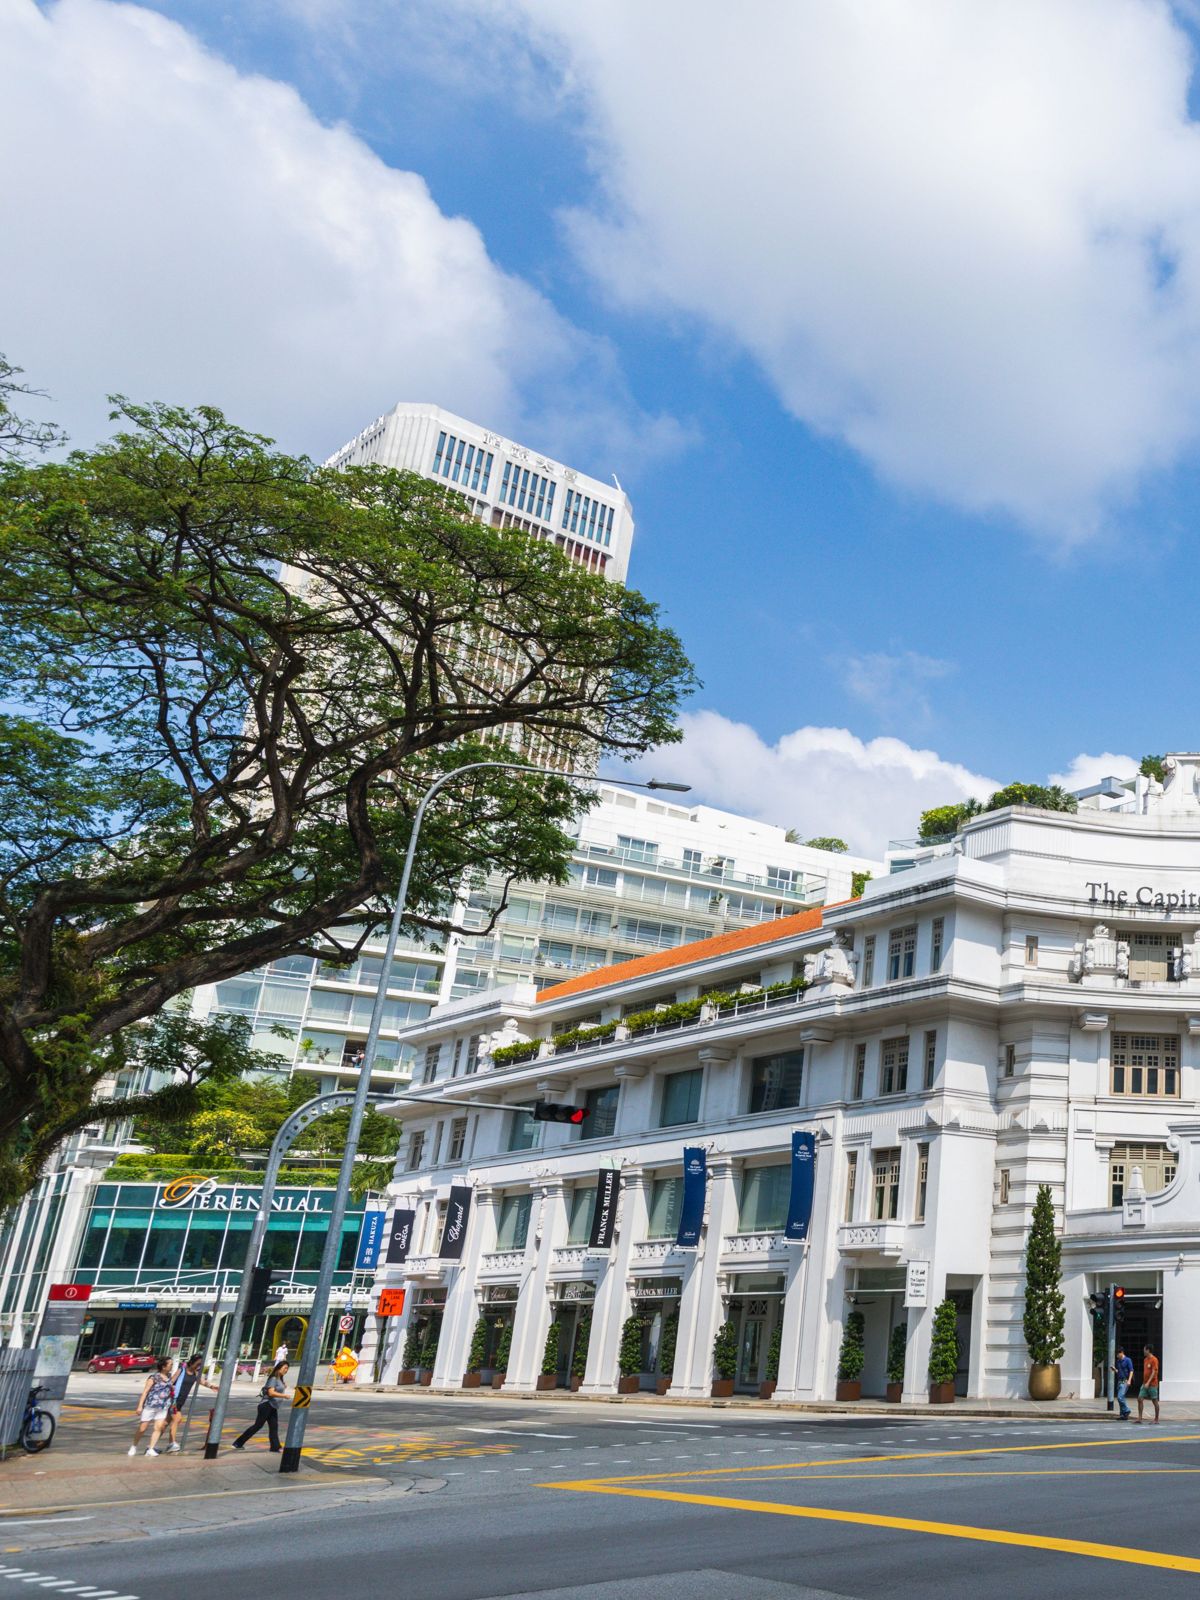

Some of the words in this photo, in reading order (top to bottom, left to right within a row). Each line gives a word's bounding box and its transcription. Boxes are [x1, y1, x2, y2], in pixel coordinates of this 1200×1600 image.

[1085, 882, 1128, 904] The
[159, 1175, 324, 1212] PERENNIAL
[448, 1202, 464, 1242] Chopard
[597, 1209, 609, 1245] FRANCK
[603, 1172, 614, 1207] MULLER
[368, 1216, 378, 1245] HAKUZA
[400, 1224, 410, 1250] OMEGA
[635, 1288, 656, 1296] FRANCK
